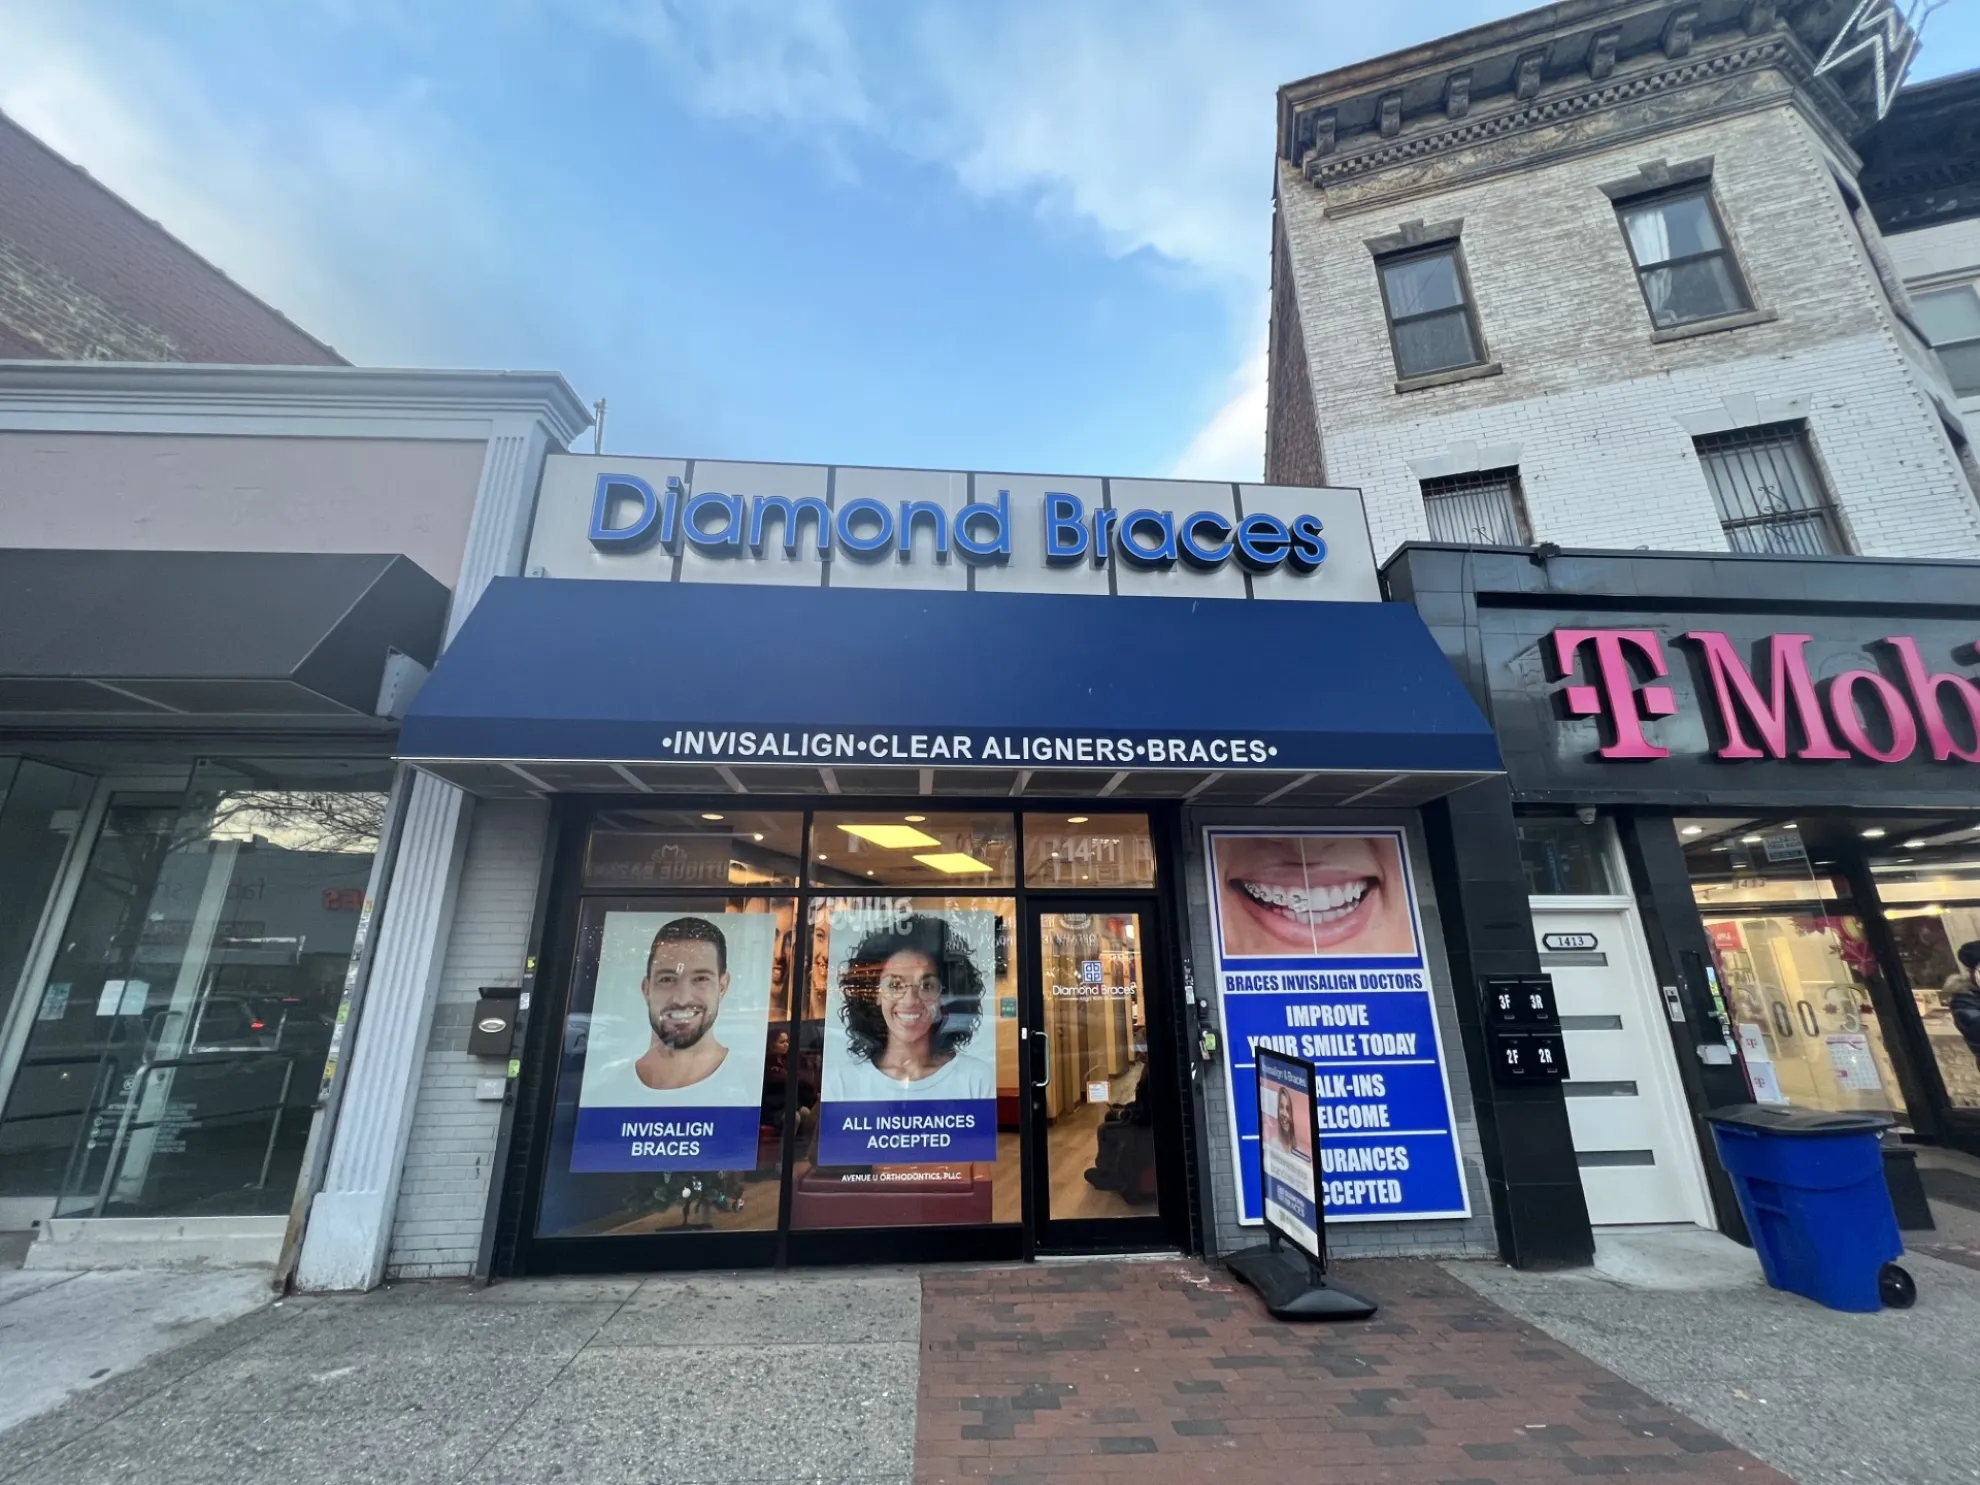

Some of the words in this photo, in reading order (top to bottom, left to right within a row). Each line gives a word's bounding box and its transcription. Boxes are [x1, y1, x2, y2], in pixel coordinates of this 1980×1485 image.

[588, 472, 1012, 562] Diamond
[1044, 491, 1329, 570] Braces
[1686, 631, 1980, 763] Mob
[1062, 838, 1115, 862] 1411
[1558, 936, 1585, 947] 1413
[1052, 984, 1099, 996] Diamond
[1101, 984, 1135, 996] Braces
[1225, 975, 1279, 992] BRACES
[1282, 974, 1357, 991] INVISALIGN
[1361, 973, 1422, 990] DOCTORS
[1498, 994, 1511, 1010] 3F
[1529, 994, 1544, 1010] 3R
[1286, 1004, 1369, 1027] IMPROVE
[1301, 1034, 1357, 1058] SMILE
[1358, 1033, 1416, 1056] TODAY
[1506, 1049, 1519, 1064] 2F
[1538, 1048, 1553, 1064] 2R
[1315, 1074, 1386, 1098] ALK-INS
[842, 1117, 872, 1131] ALL
[876, 1114, 976, 1131] INSURANCES
[1317, 1104, 1391, 1129] ELCOME
[621, 1122, 714, 1137] INVISALIGN
[631, 1141, 700, 1156] BRACES
[866, 1133, 951, 1149] ACCEPTED
[1320, 1146, 1410, 1173] URANCES
[841, 1174, 871, 1183] AVENUE
[872, 1174, 879, 1182] U
[880, 1172, 942, 1182] ORTHODONTICS,
[944, 1172, 962, 1181] PLLC
[1322, 1178, 1403, 1206] CCEPTED
